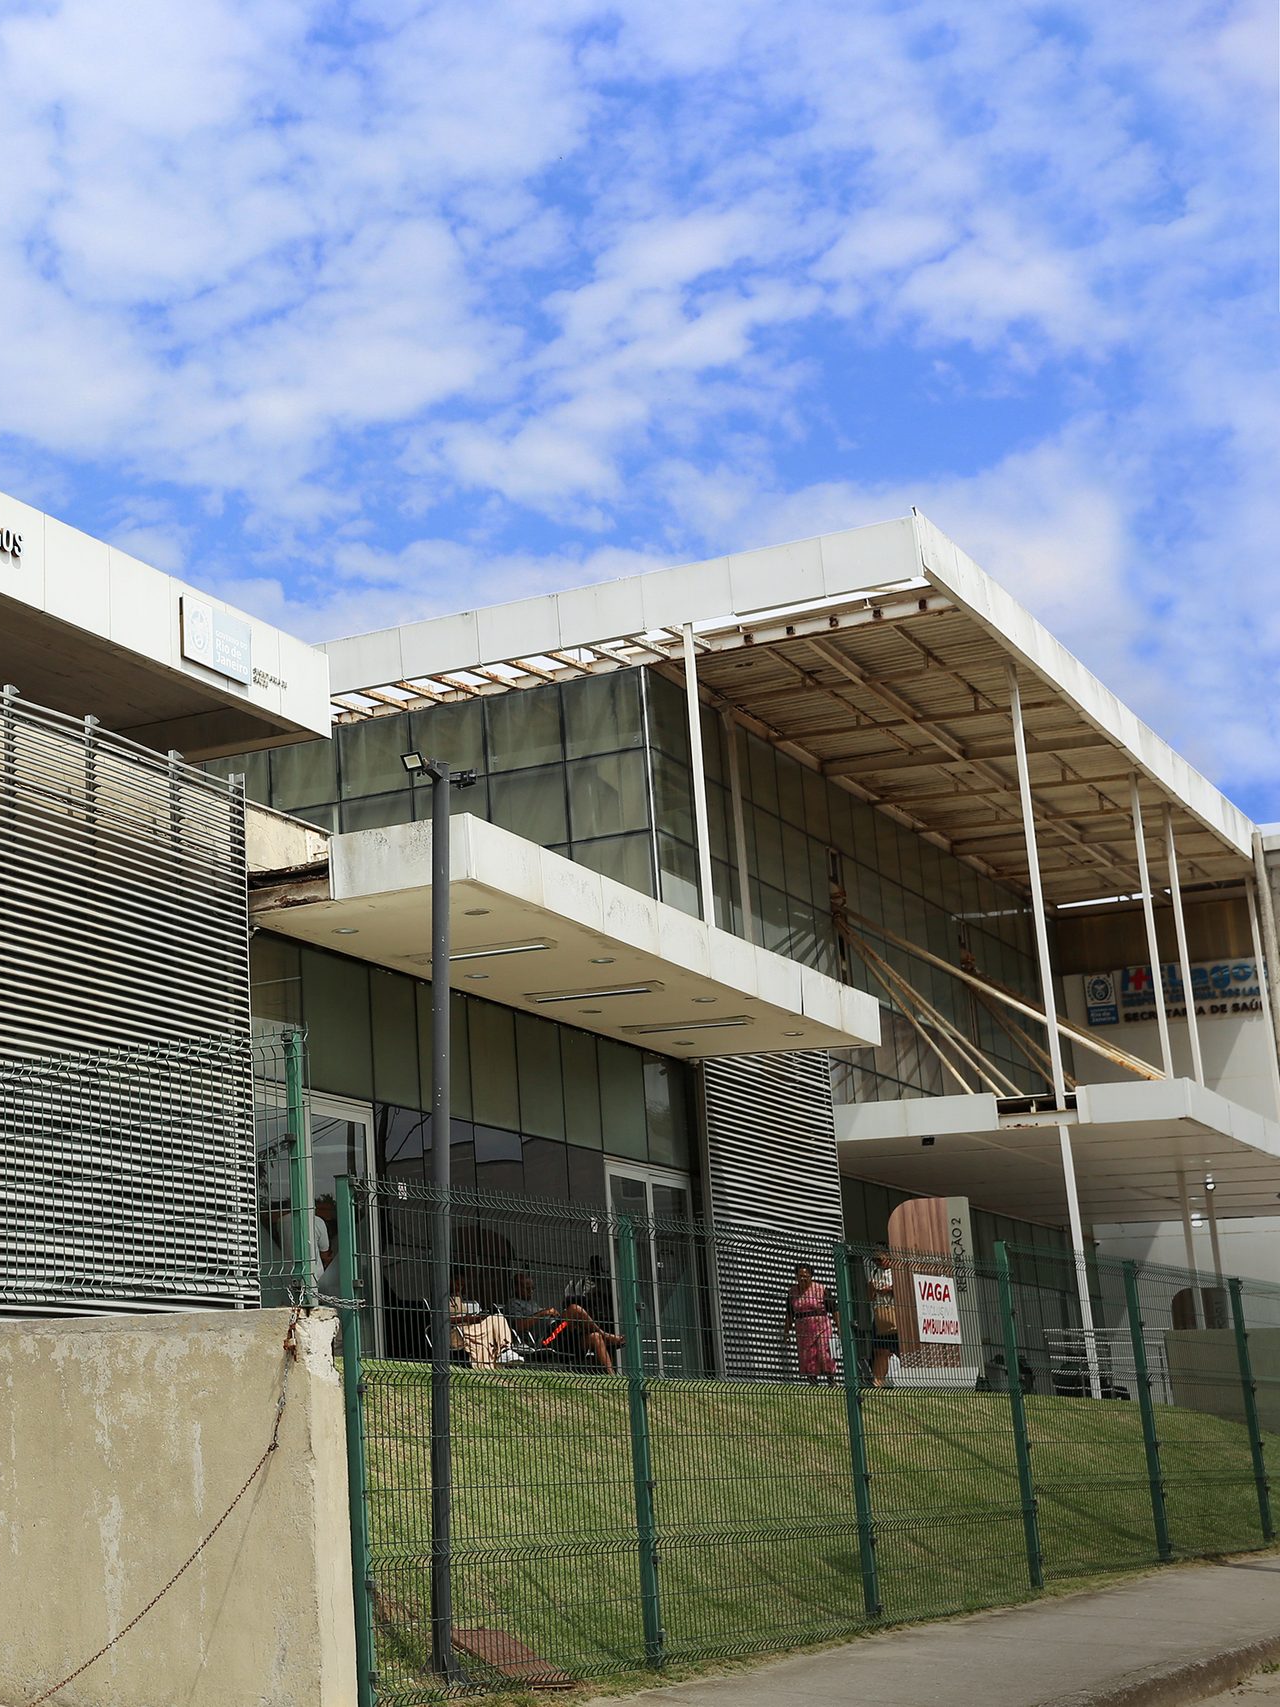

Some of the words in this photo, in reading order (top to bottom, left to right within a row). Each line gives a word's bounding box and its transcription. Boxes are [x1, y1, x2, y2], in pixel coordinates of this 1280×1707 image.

[215, 638, 230, 655] Rio
[231, 646, 242, 660] de
[215, 651, 249, 676] Janeiro
[1124, 1007, 1206, 1022] SECRTAA
[1210, 1004, 1227, 1014] DE
[1232, 999, 1263, 1013] SAÚ
[918, 1281, 951, 1302] VAGA
